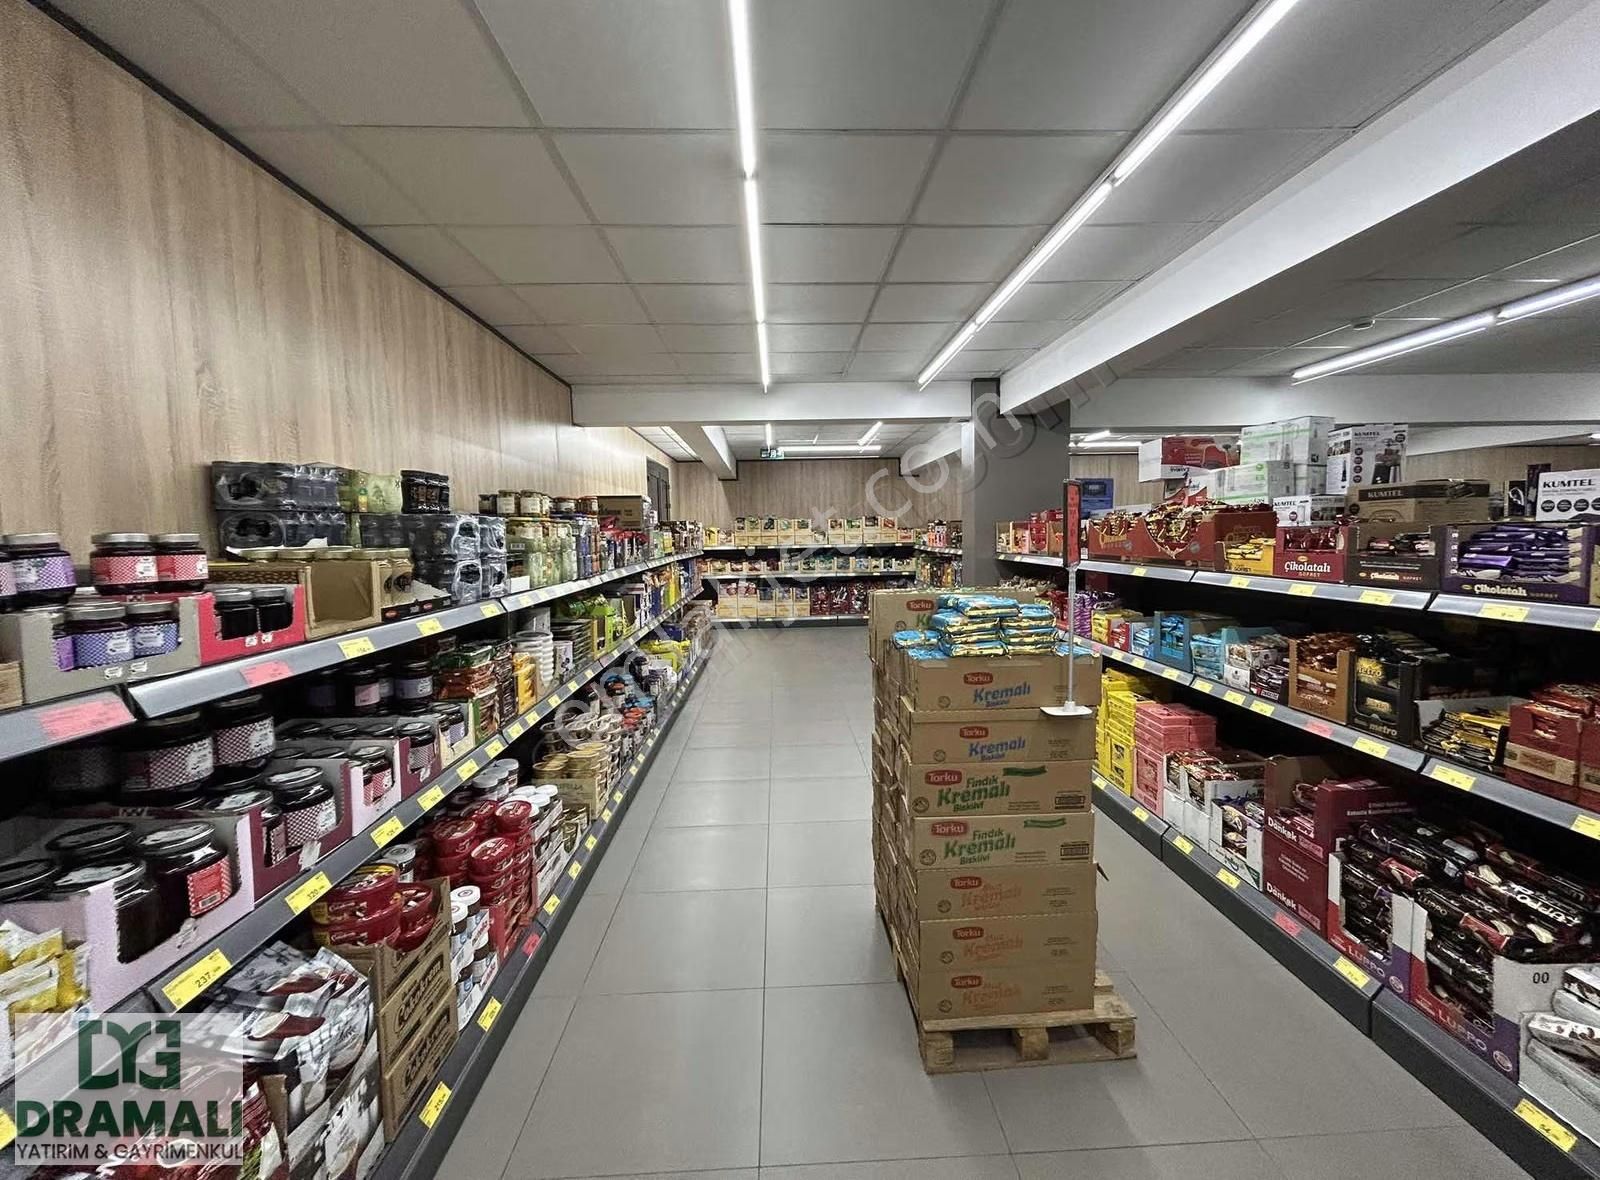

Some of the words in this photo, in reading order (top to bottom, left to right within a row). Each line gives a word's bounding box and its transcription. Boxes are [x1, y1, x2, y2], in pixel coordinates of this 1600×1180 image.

[1543, 478, 1596, 489] KUMTEL
[1367, 490, 1403, 498] KUMTEL
[1284, 561, 1331, 572] Çikolatalı
[965, 673, 991, 683] Torku
[972, 681, 1031, 704] Kremalı
[961, 728, 987, 737] Torku
[1369, 723, 1398, 736] metro
[968, 736, 1026, 758] Kremalı
[928, 772, 959, 783] Torku
[965, 775, 999, 789] Fındık
[936, 780, 1011, 808] Kremalı
[933, 823, 965, 834] Torku
[972, 828, 1005, 841] Fındık
[943, 833, 1017, 860] Kremalı
[953, 878, 979, 888] Torku
[955, 929, 981, 938] Torku
[1348, 944, 1386, 978] LUPPO
[194, 971, 212, 988] 237
[953, 978, 979, 987] Torku
[1532, 971, 1550, 985] 00
[1438, 1009, 1487, 1052] LUPPO
